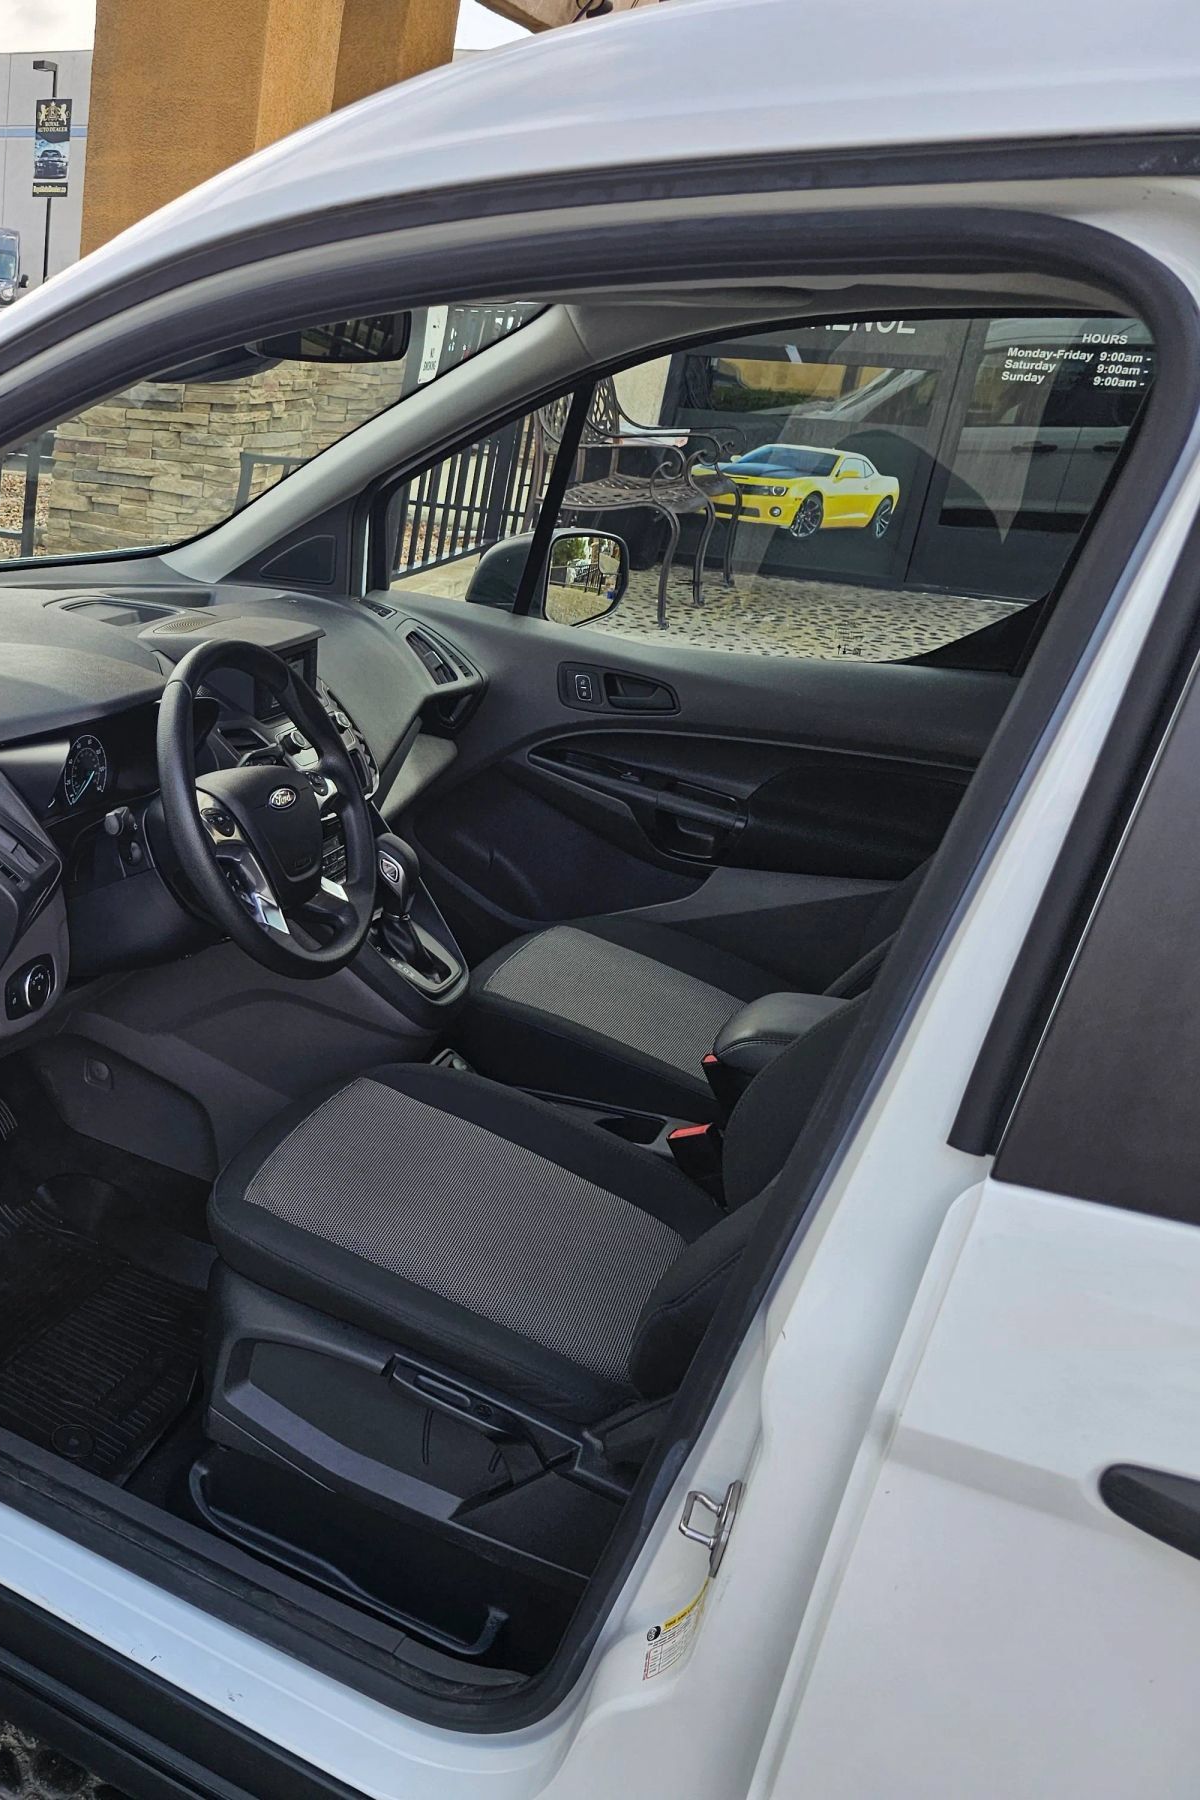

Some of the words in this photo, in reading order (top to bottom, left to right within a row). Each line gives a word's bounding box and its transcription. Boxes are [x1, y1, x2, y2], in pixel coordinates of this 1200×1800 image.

[1082, 333, 1128, 345] HOURS
[1007, 347, 1094, 363] Monday-Friday
[1099, 351, 1143, 363] 9:00am
[1004, 359, 1056, 373] Saturday
[1096, 363, 1140, 375] 9:00am
[1001, 371, 1045, 385] Sunday
[1093, 376, 1137, 388] 9:00am
[271, 790, 293, 806] Ford
